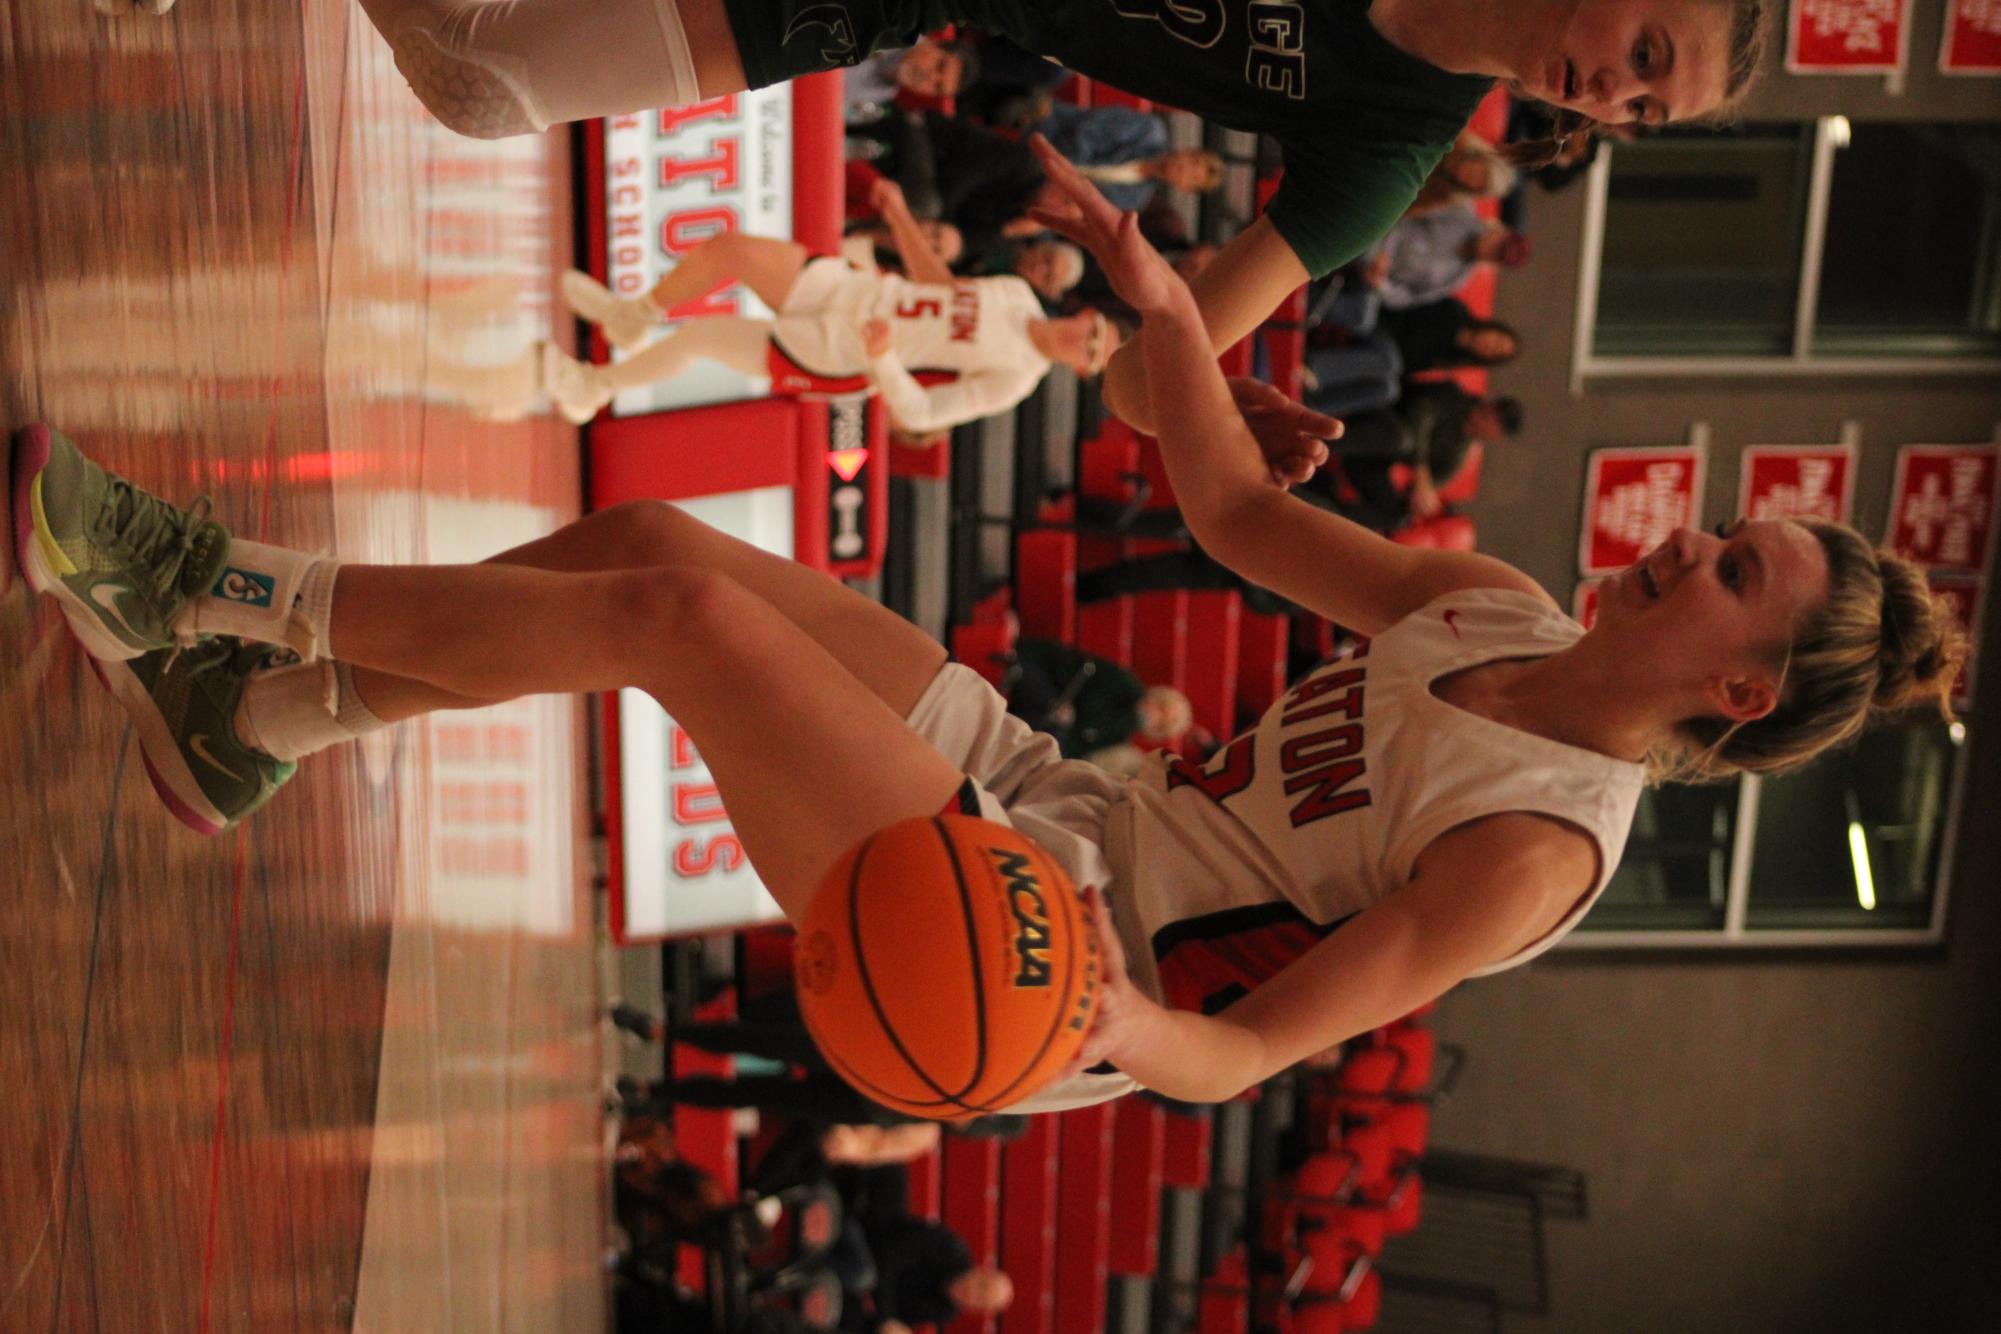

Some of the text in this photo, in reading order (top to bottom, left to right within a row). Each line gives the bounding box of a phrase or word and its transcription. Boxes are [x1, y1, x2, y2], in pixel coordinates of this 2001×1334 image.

[1245, 0, 1305, 99] GE
[895, 300, 941, 319] 5
[670, 726, 745, 878] DS
[988, 848, 1052, 988] NCAA
